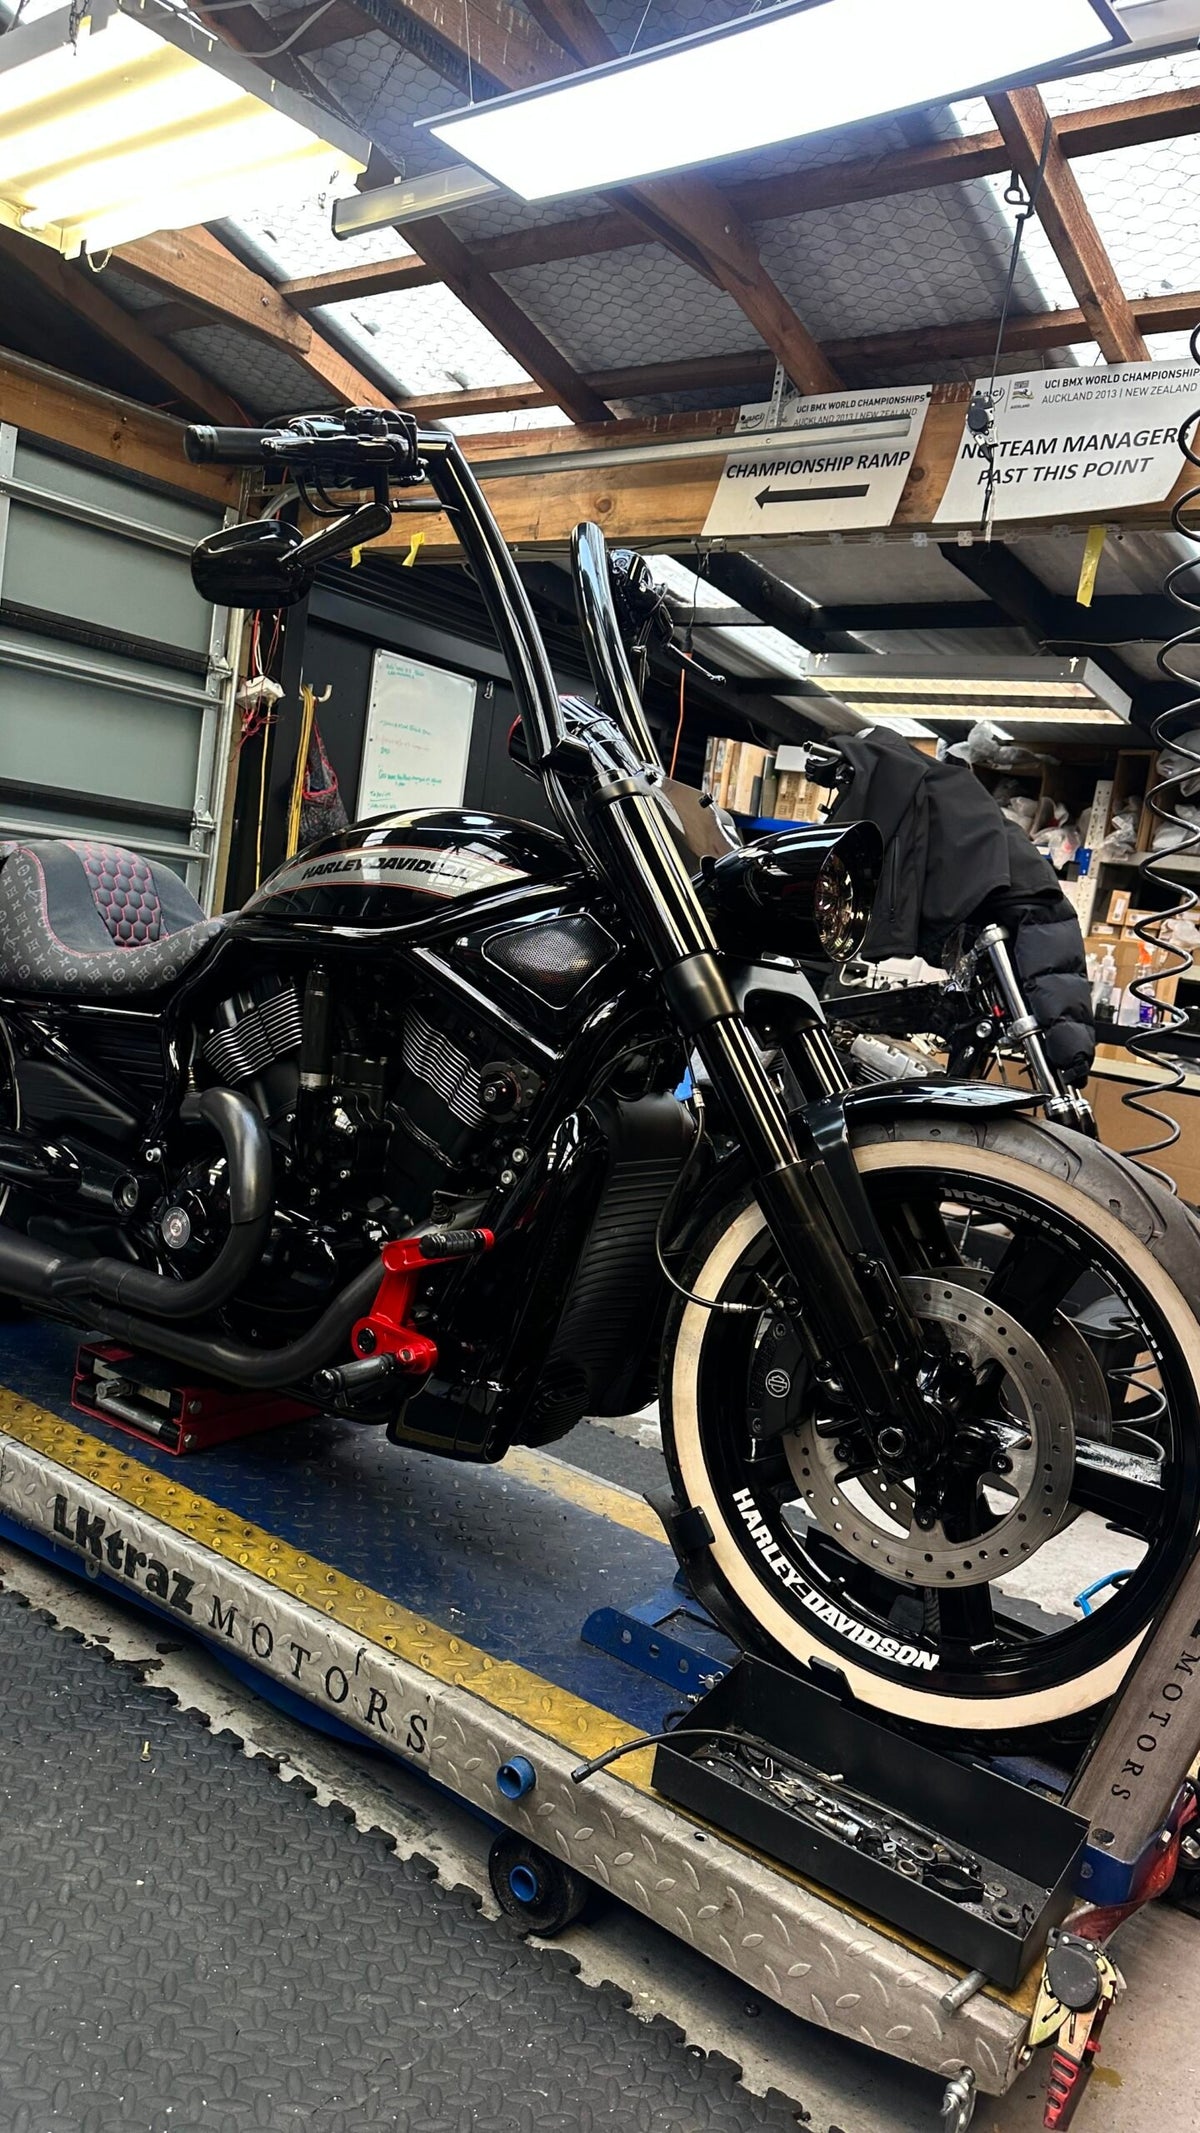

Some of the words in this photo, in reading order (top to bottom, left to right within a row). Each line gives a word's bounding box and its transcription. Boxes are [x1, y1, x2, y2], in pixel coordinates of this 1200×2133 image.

[1045, 379, 1060, 389] UCI
[1062, 377, 1084, 388] BMX
[1085, 373, 1120, 386] WORLD
[1122, 368, 1200, 382] CHAMPIONSHIP
[796, 404, 809, 414] UCI
[810, 402, 827, 412] BMX
[828, 400, 856, 409] WORLD
[857, 394, 926, 407] CHAMPIONSHIPS
[1041, 391, 1093, 404] AUCKLAND
[1095, 388, 1117, 400] 2013
[1125, 386, 1149, 397] NEW
[1150, 383, 1198, 396] ZEALAND
[793, 415, 835, 427] AUCKLAND
[836, 413, 854, 422] 2013
[860, 411, 879, 420] NEW
[880, 408, 918, 417] ZEALAND
[1000, 438, 1058, 458] TEAM
[726, 457, 854, 479] CHAMPIONSHIP
[857, 451, 911, 471] RAMP
[977, 468, 1028, 486] PAST
[1033, 464, 1078, 482] THIS
[1082, 457, 1154, 478] POINT
[301, 857, 475, 881] HARLEYDAVIDSON
[732, 1487, 940, 1671] HARLEY-DAVIDSON
[53, 1493, 195, 1615] LKtraz
[207, 1594, 429, 1754] MOTORS
[1111, 1650, 1200, 1801] MOTORS
